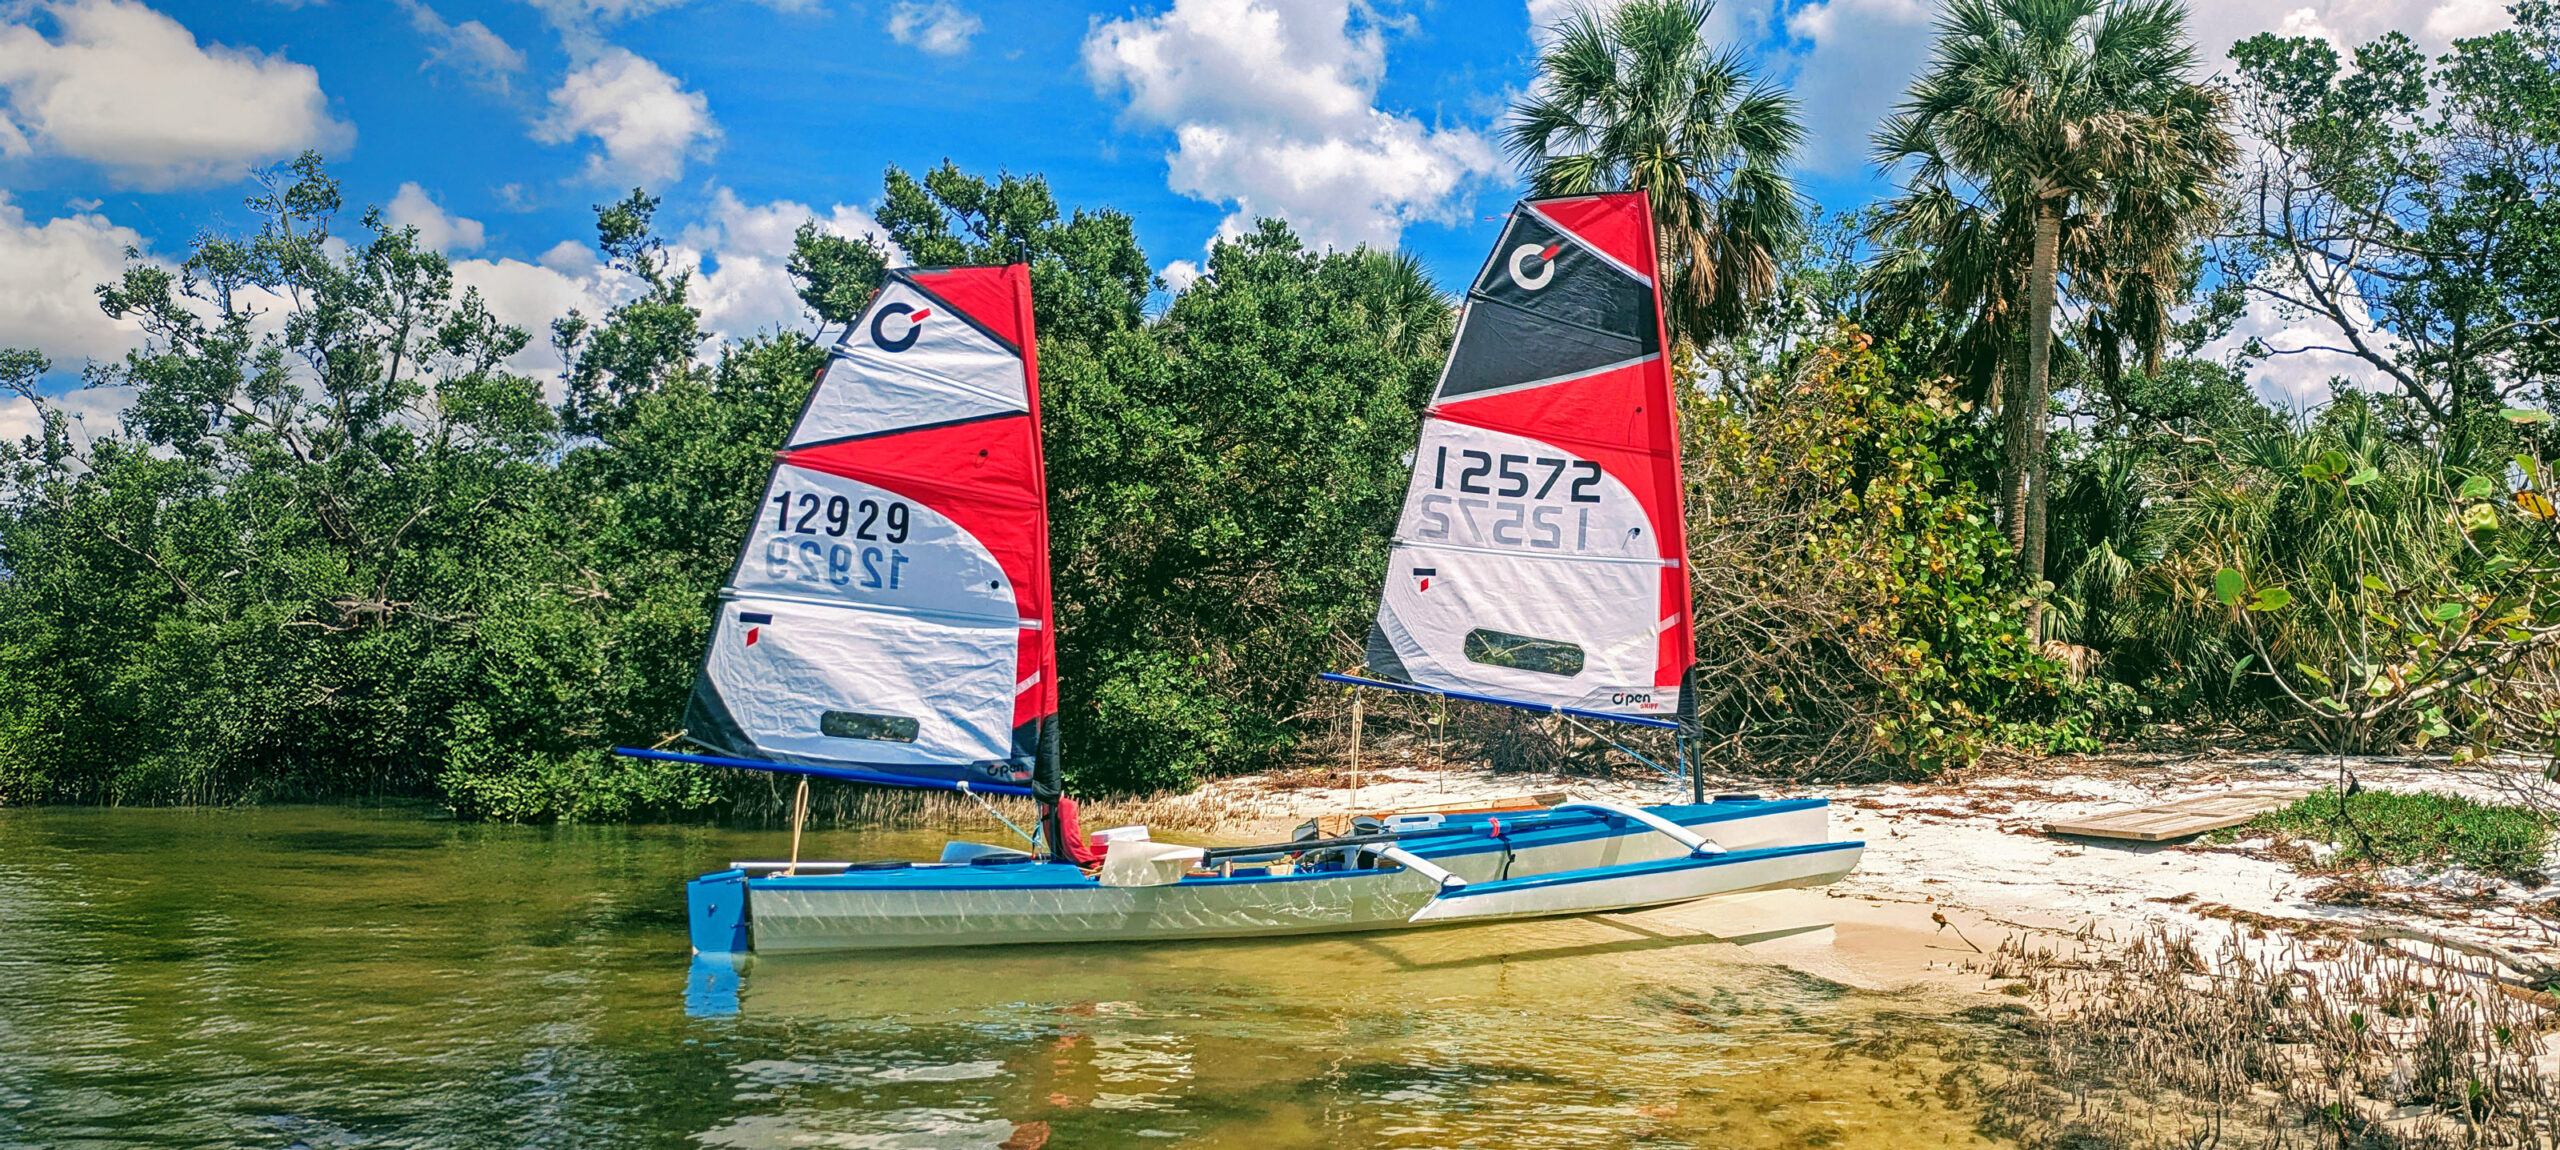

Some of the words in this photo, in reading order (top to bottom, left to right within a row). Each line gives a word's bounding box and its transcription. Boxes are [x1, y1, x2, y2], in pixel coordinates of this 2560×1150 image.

[1435, 446, 1602, 503] 12572
[773, 491, 910, 544] 12929
[1612, 692, 1651, 706] Open
[987, 763, 1025, 777] Open
